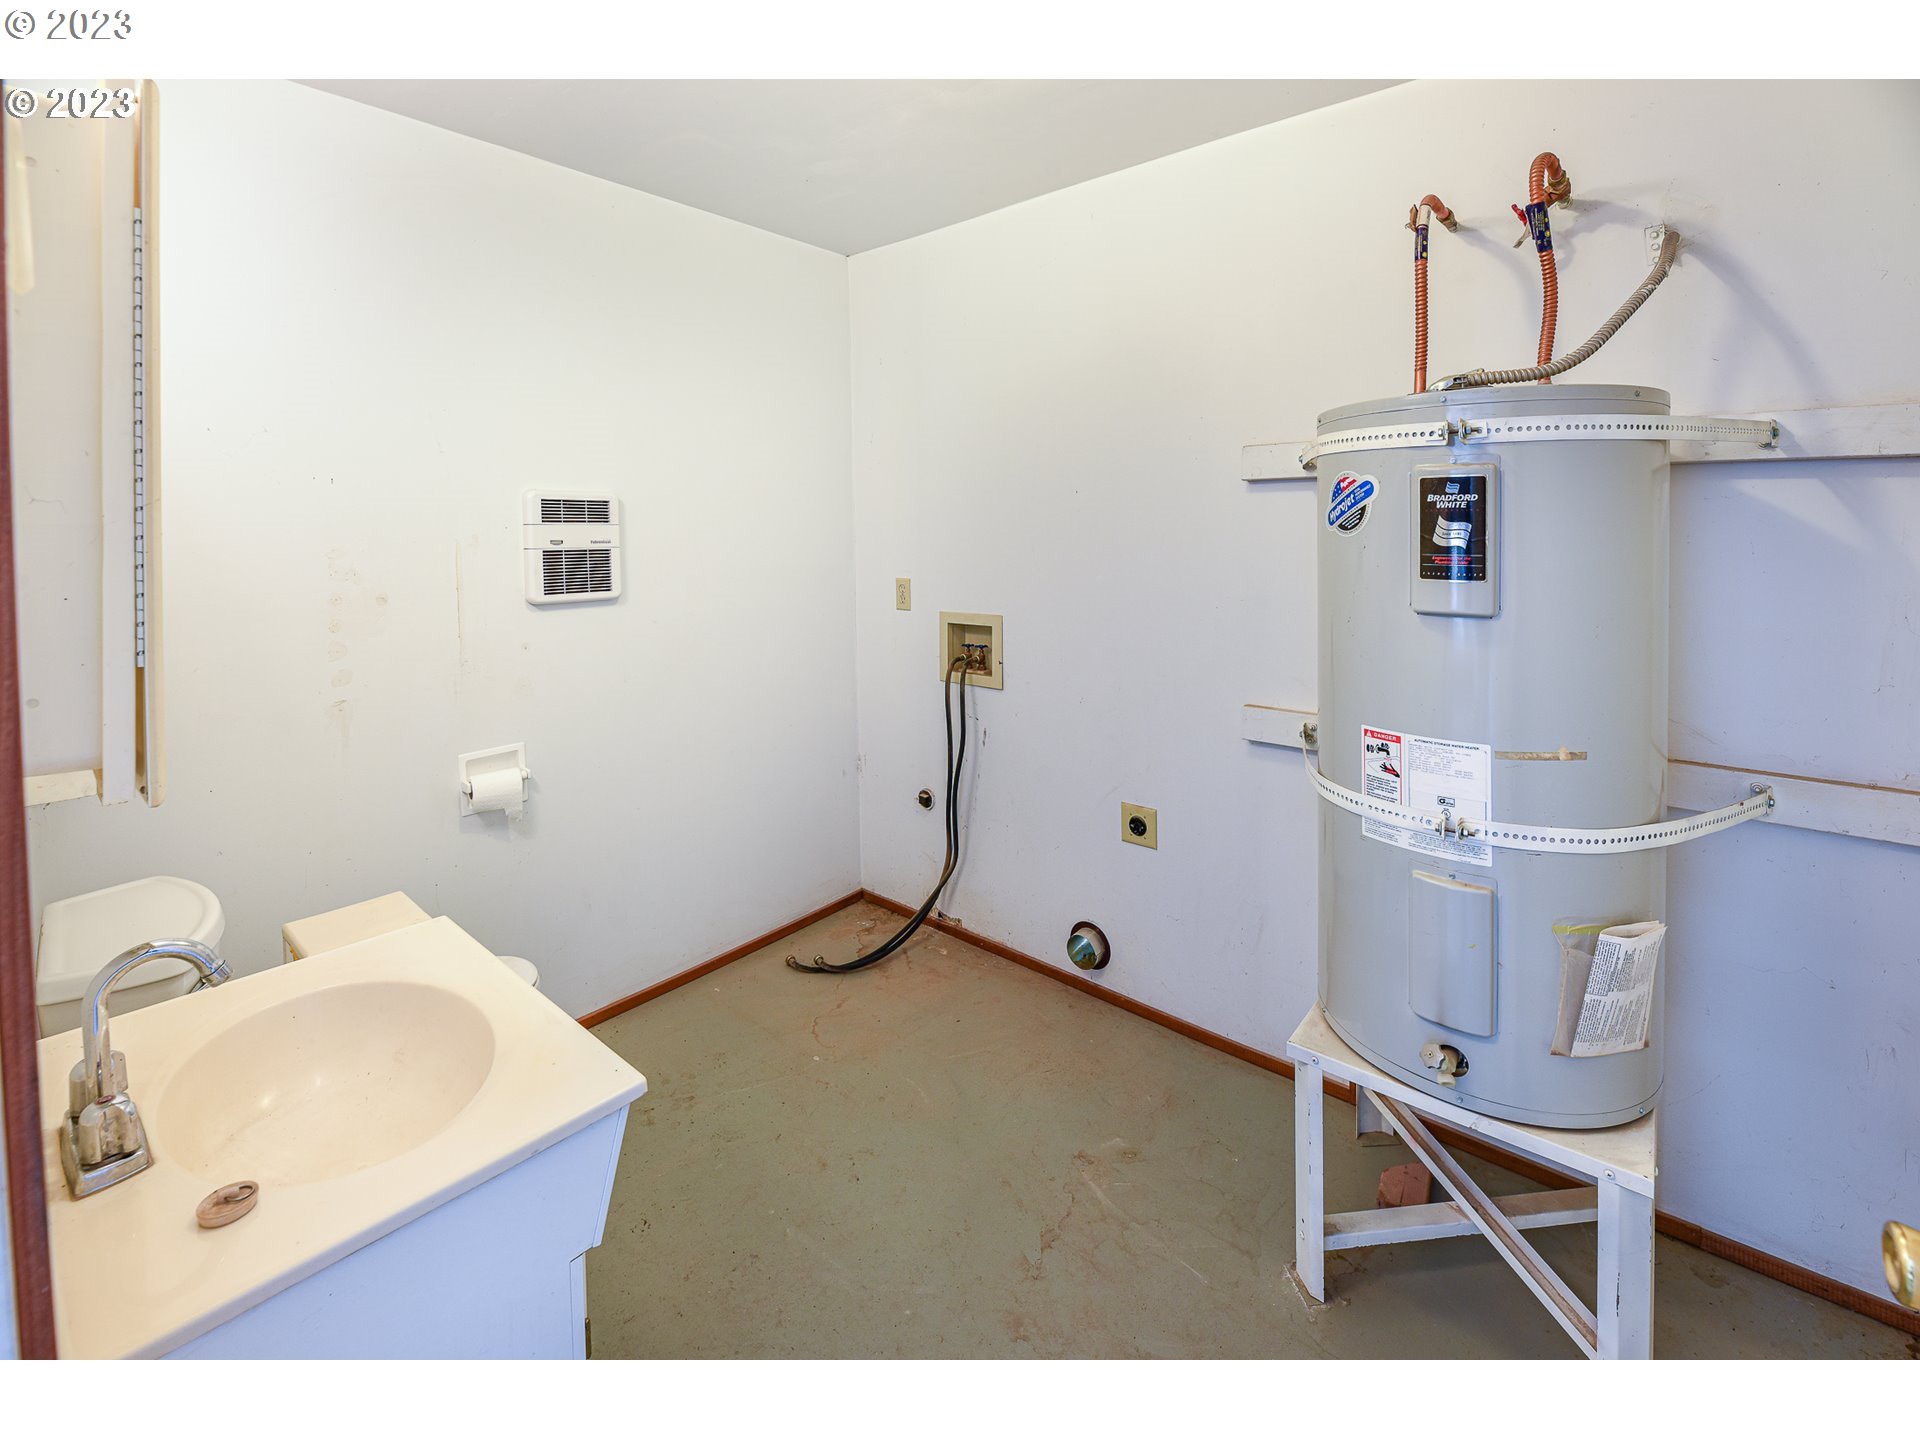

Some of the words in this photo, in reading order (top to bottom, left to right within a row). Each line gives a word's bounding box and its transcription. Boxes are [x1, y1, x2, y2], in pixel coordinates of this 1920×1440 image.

[1427, 494, 1479, 502] BRADFORD
[1436, 501, 1468, 509] WHITE
[1373, 731, 1397, 741] DANGER
